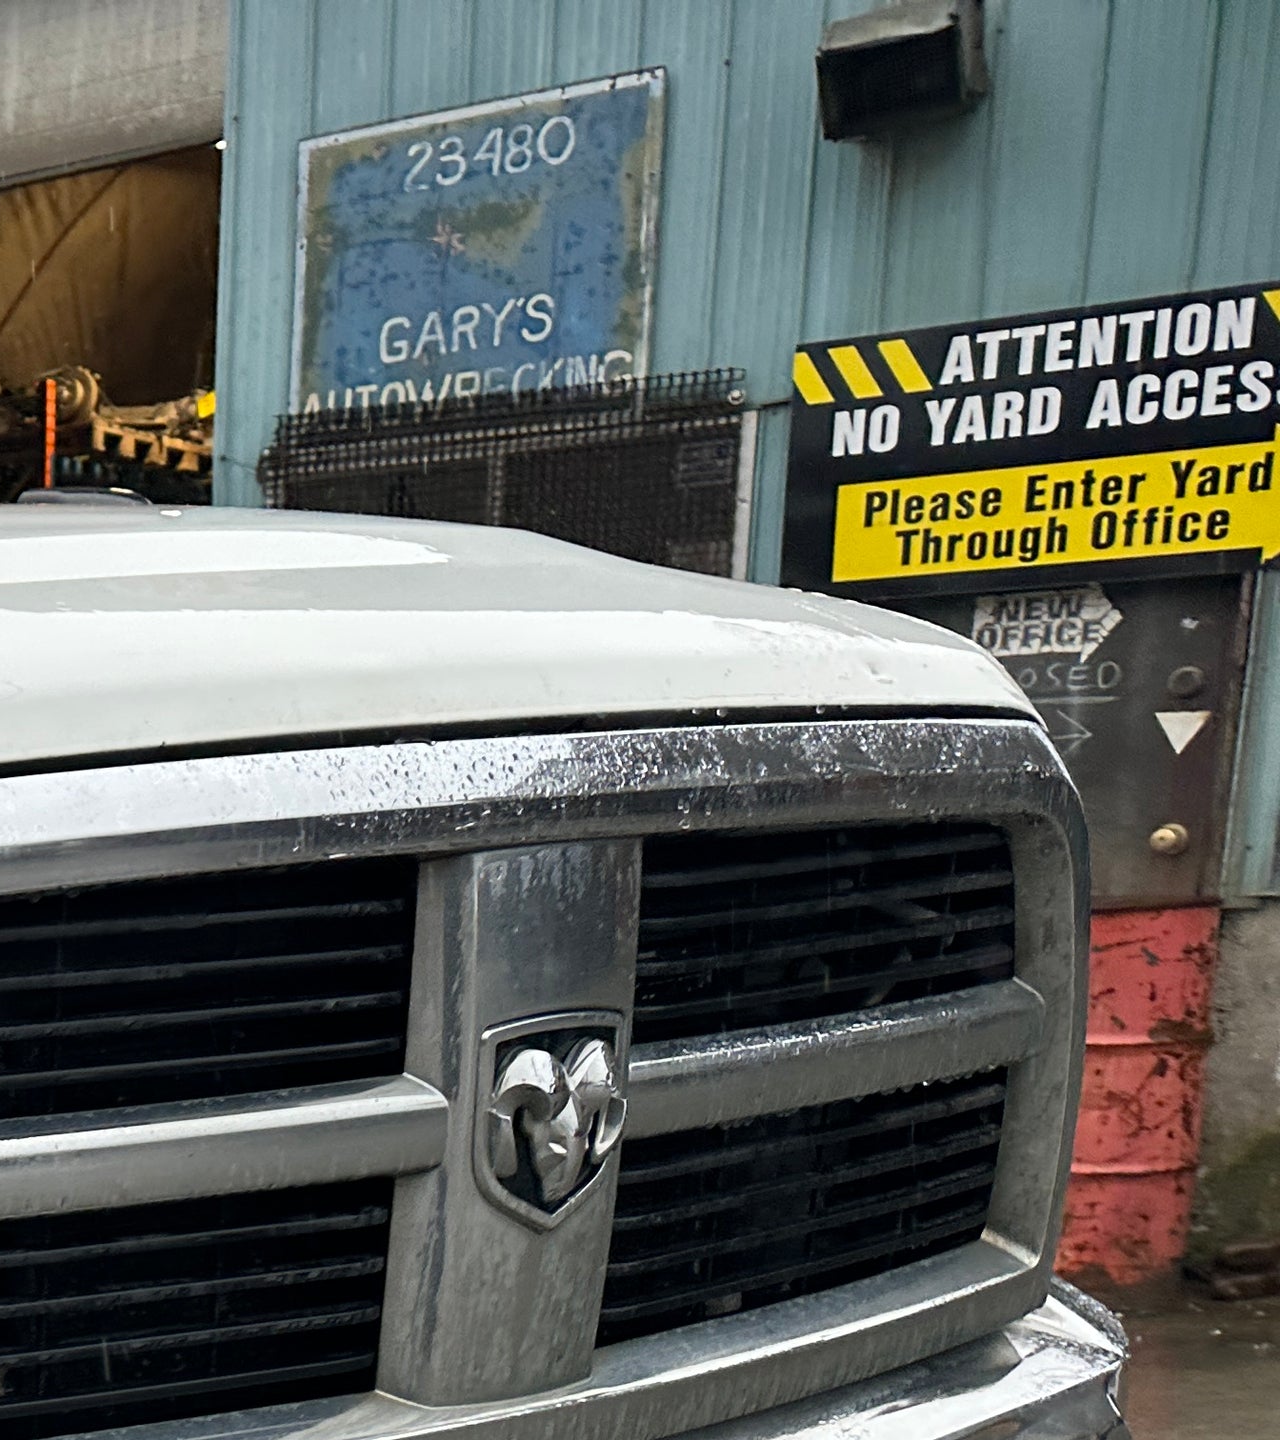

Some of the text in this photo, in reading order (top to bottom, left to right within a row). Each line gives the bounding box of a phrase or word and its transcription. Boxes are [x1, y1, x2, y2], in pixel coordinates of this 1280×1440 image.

[403, 116, 576, 193] 23480
[379, 294, 555, 364] GARY'S
[939, 297, 1256, 385] ATTENTION
[832, 360, 1280, 457] NO YARD ACCES
[864, 452, 1275, 528] Please Enter Yard
[896, 506, 1231, 566] Through Office
[977, 618, 1102, 651] OFFICE
[998, 593, 1081, 620] NEW
[1018, 661, 1121, 691] OSED
